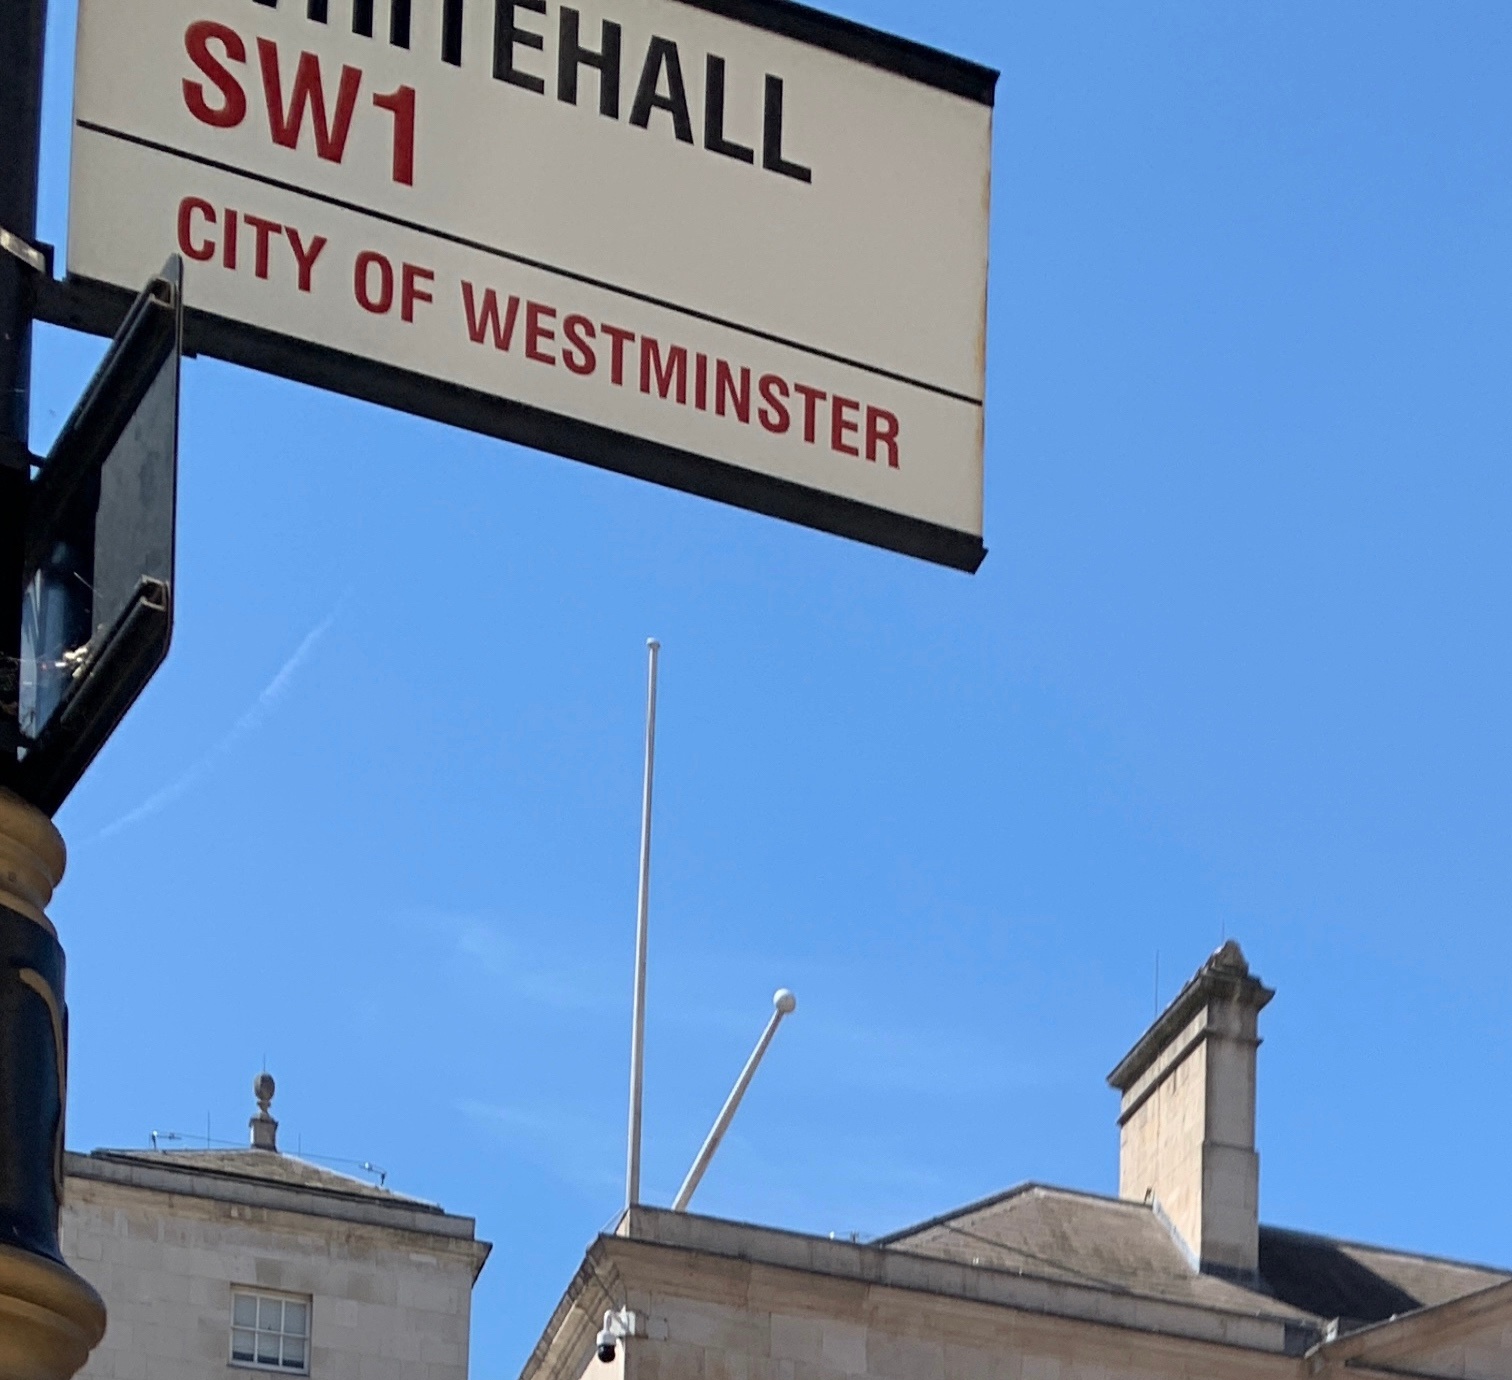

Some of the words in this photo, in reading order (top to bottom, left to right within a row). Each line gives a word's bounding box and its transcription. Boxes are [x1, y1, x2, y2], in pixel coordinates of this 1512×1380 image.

[182, 20, 416, 187] SW1
[254, 0, 812, 185] TEHALL
[177, 196, 328, 293] CITY
[354, 251, 435, 323] OF
[461, 280, 900, 470] WESTMINSTER
